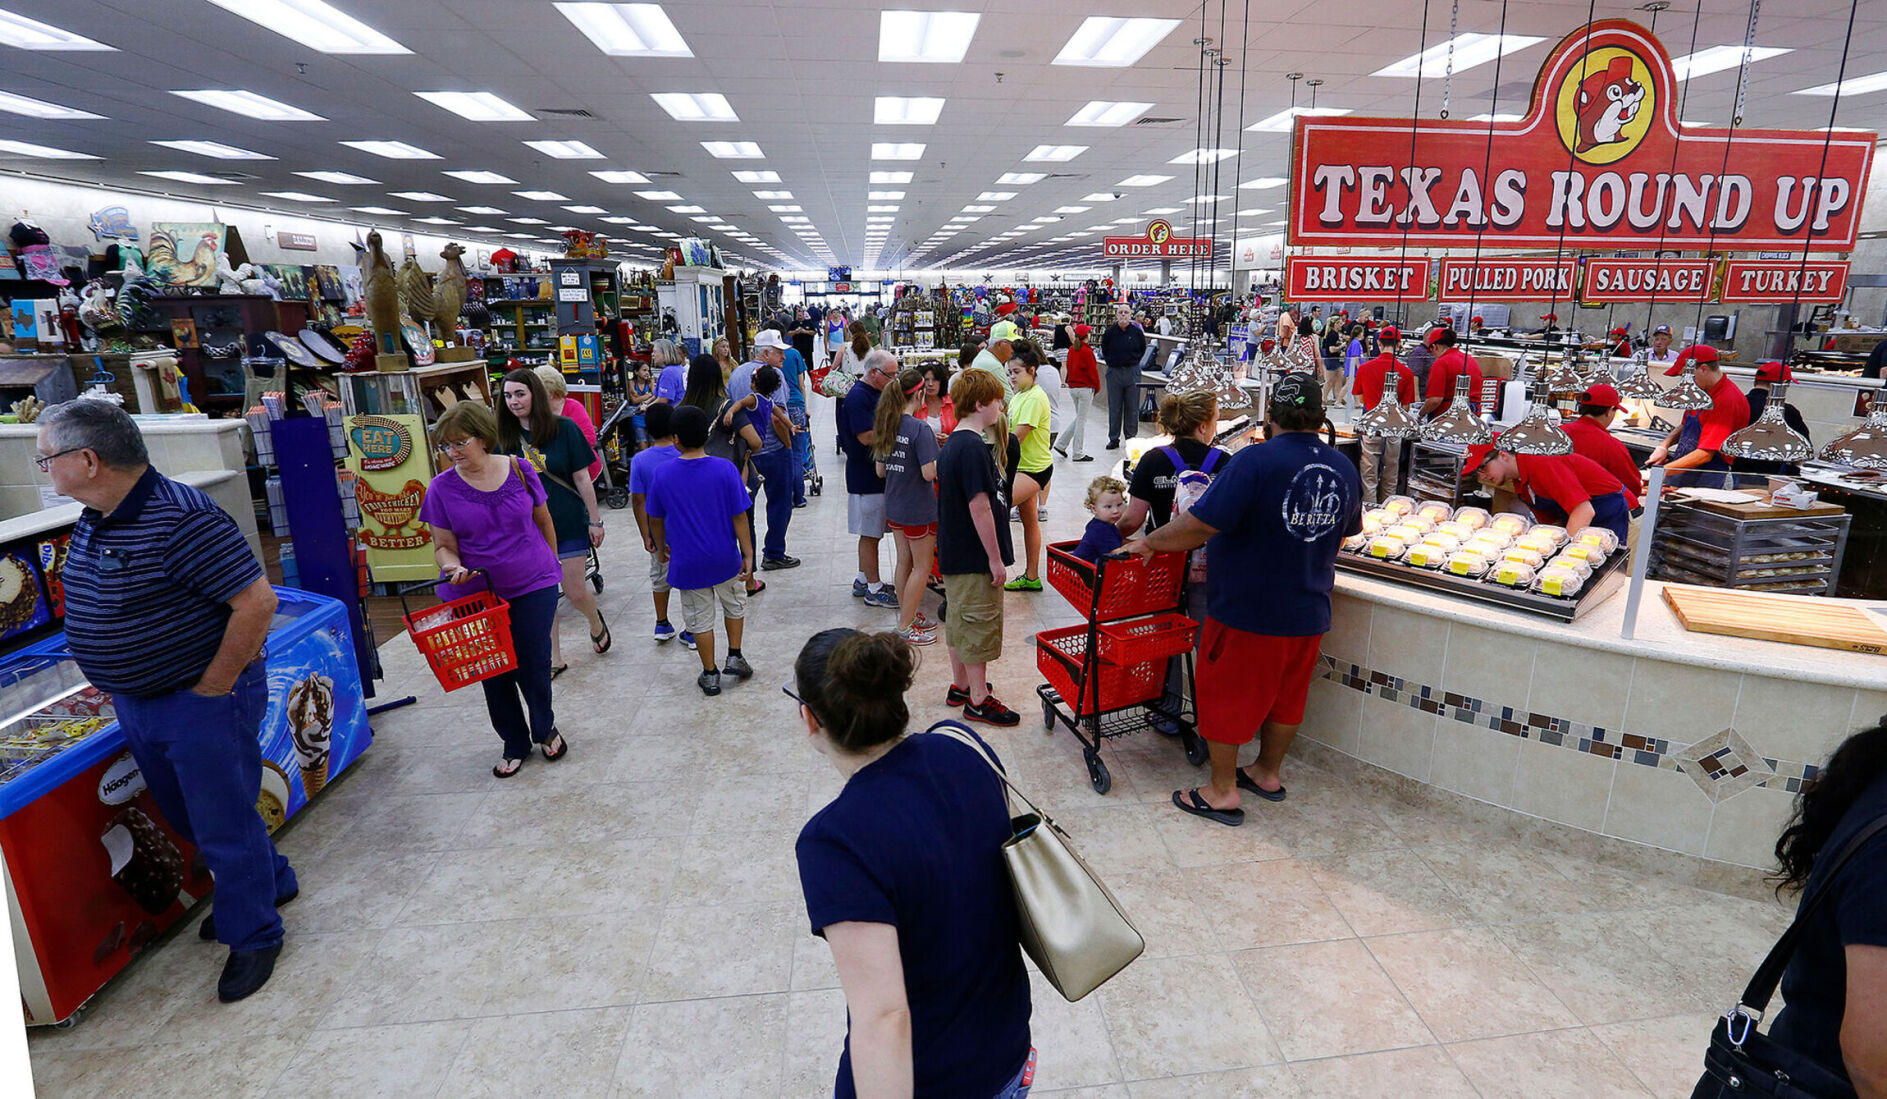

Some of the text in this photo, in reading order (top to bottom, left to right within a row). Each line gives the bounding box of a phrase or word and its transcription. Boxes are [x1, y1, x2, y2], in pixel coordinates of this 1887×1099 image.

[1313, 164, 1850, 235] TEXAS ROUND UP
[1108, 244, 1209, 256] ORDER HERE
[1305, 266, 1414, 291] BRISKET
[1448, 267, 1570, 292] PULLED PORK
[1596, 269, 1704, 292] SAUSAGE
[1741, 270, 1835, 293] TURKEY
[362, 429, 394, 444] EAT
[362, 444, 393, 454] HERE
[369, 536, 424, 548] BETTER
